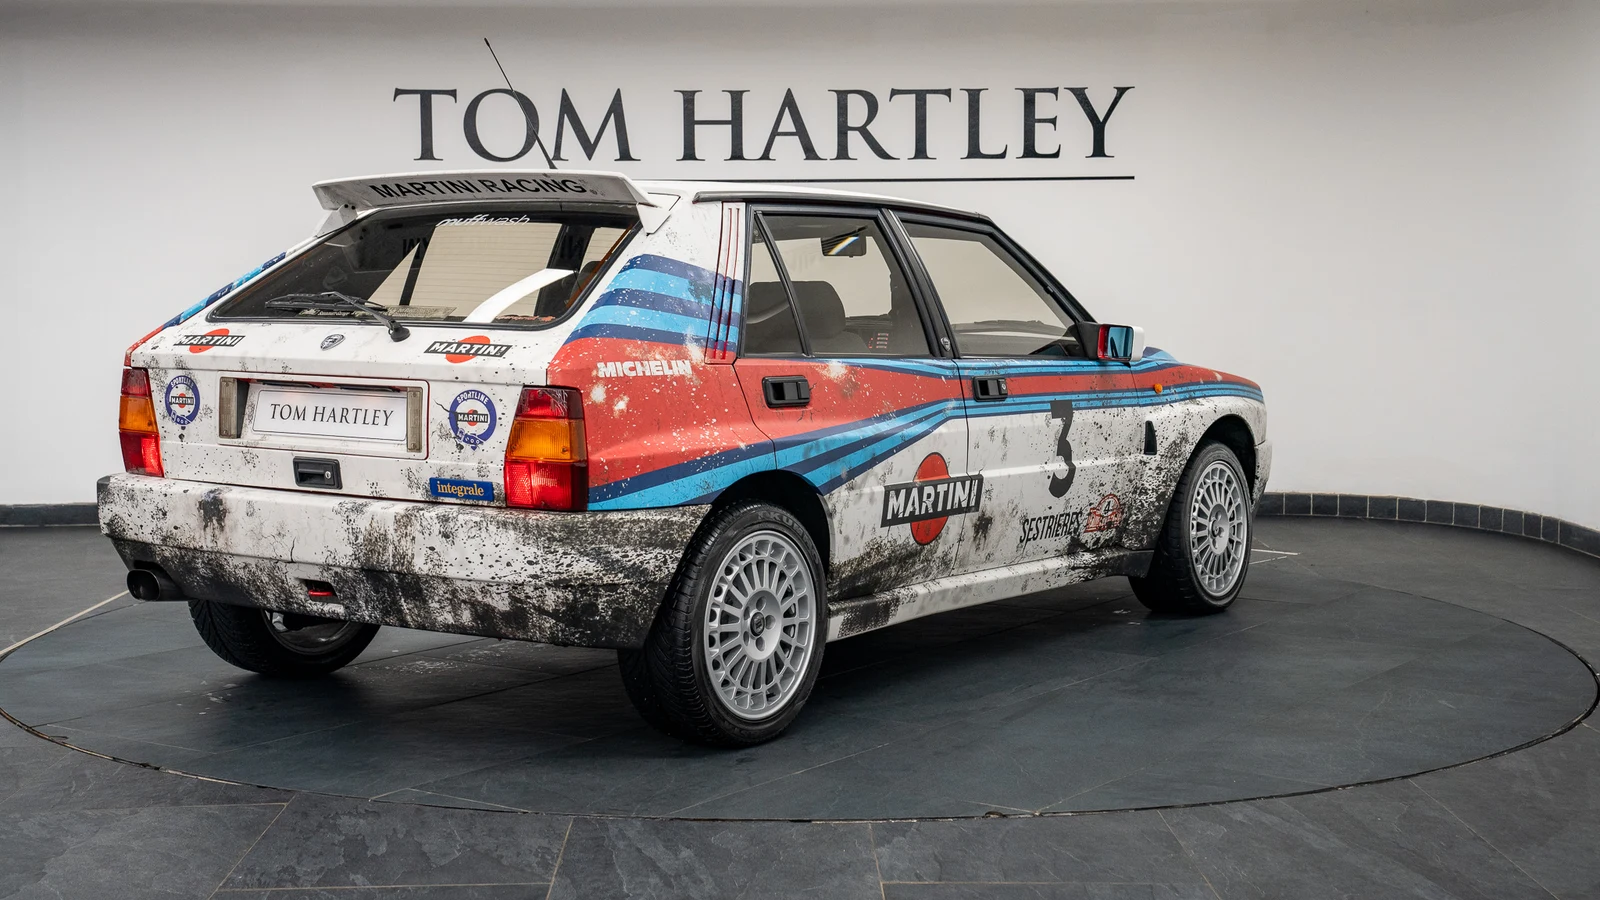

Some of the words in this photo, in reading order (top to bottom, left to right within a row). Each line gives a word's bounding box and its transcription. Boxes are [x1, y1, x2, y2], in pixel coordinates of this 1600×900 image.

[393, 87, 641, 162] TOM
[673, 86, 1135, 162] HARTLEY
[369, 179, 482, 198] MARTINI
[479, 178, 587, 194] RACING
[436, 214, 531, 227] muffwash
[181, 335, 242, 346] MARTINI
[428, 342, 508, 356] MARTINI
[597, 360, 693, 378] MICHELIN
[171, 396, 194, 405] MARTINI
[457, 391, 489, 404] SPORTLINE
[270, 403, 306, 421] TOM
[312, 405, 394, 427] HARTLEY
[457, 413, 488, 422] MARTINI
[1048, 400, 1076, 498] 3
[437, 480, 485, 497] integrale
[886, 479, 978, 520] MARTINI
[1103, 500, 1113, 515] 4
[1019, 511, 1083, 544] SESTRIERES
